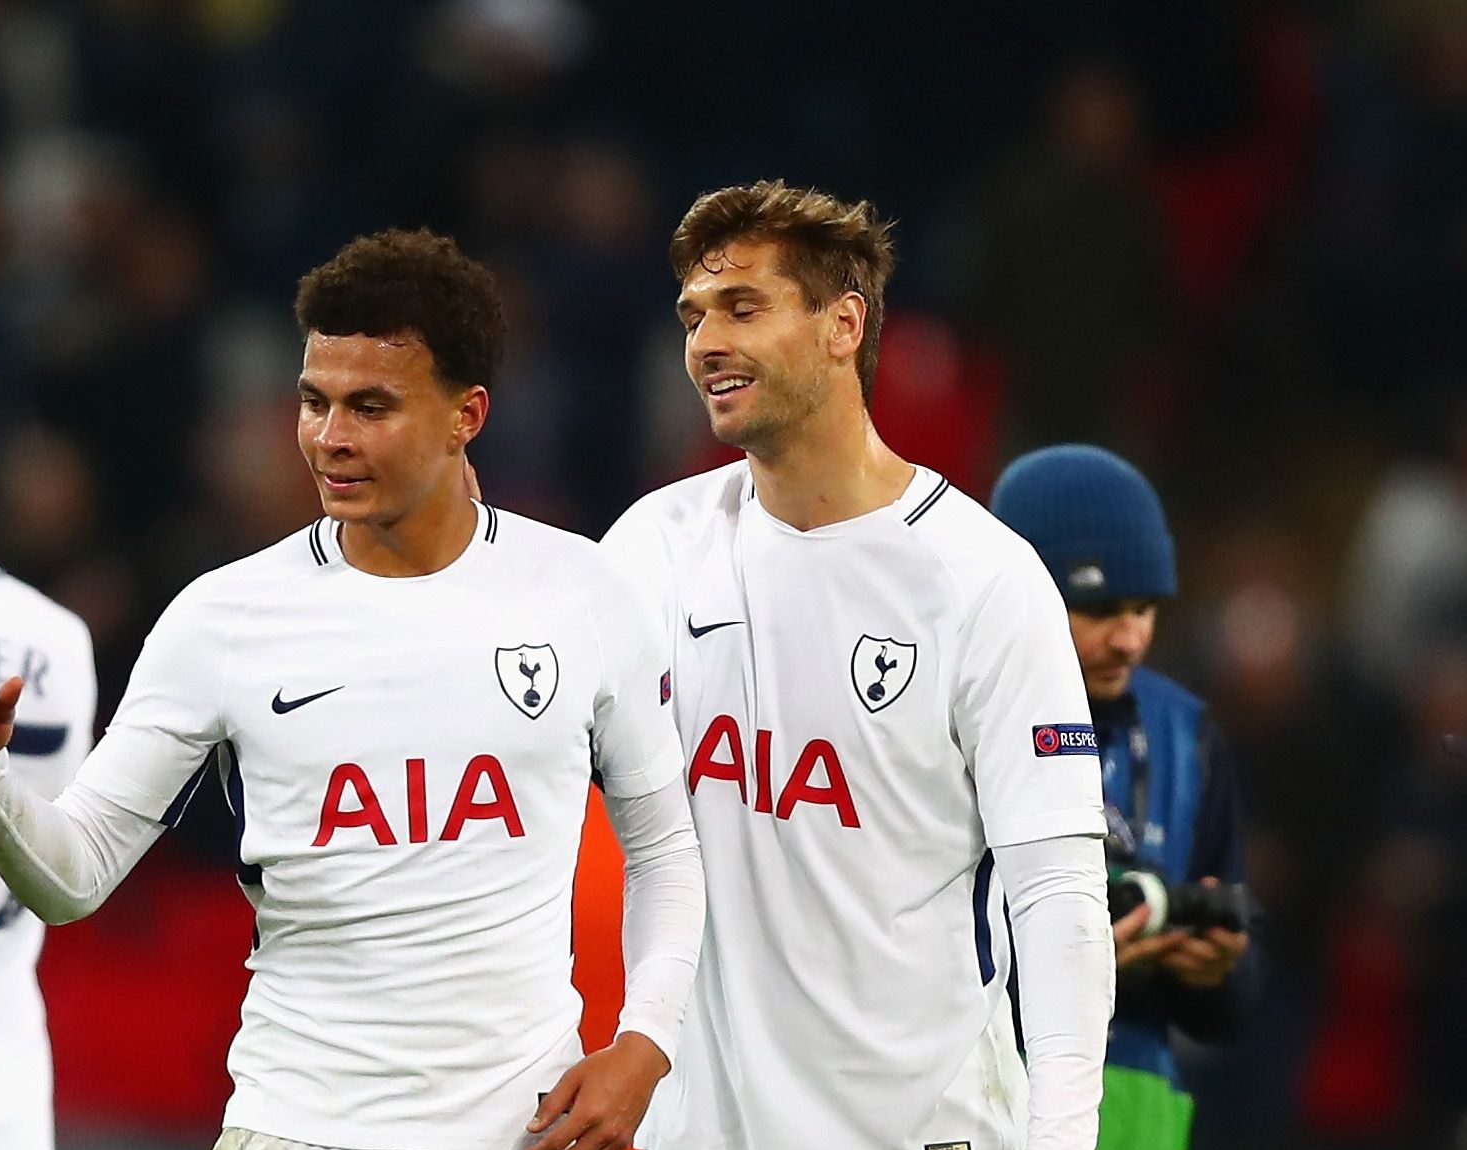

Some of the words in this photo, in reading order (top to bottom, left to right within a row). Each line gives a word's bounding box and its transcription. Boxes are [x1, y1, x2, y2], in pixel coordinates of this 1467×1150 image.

[688, 714, 862, 829] AIA
[1060, 731, 1098, 748] RESPEC
[311, 753, 526, 847] AIA
